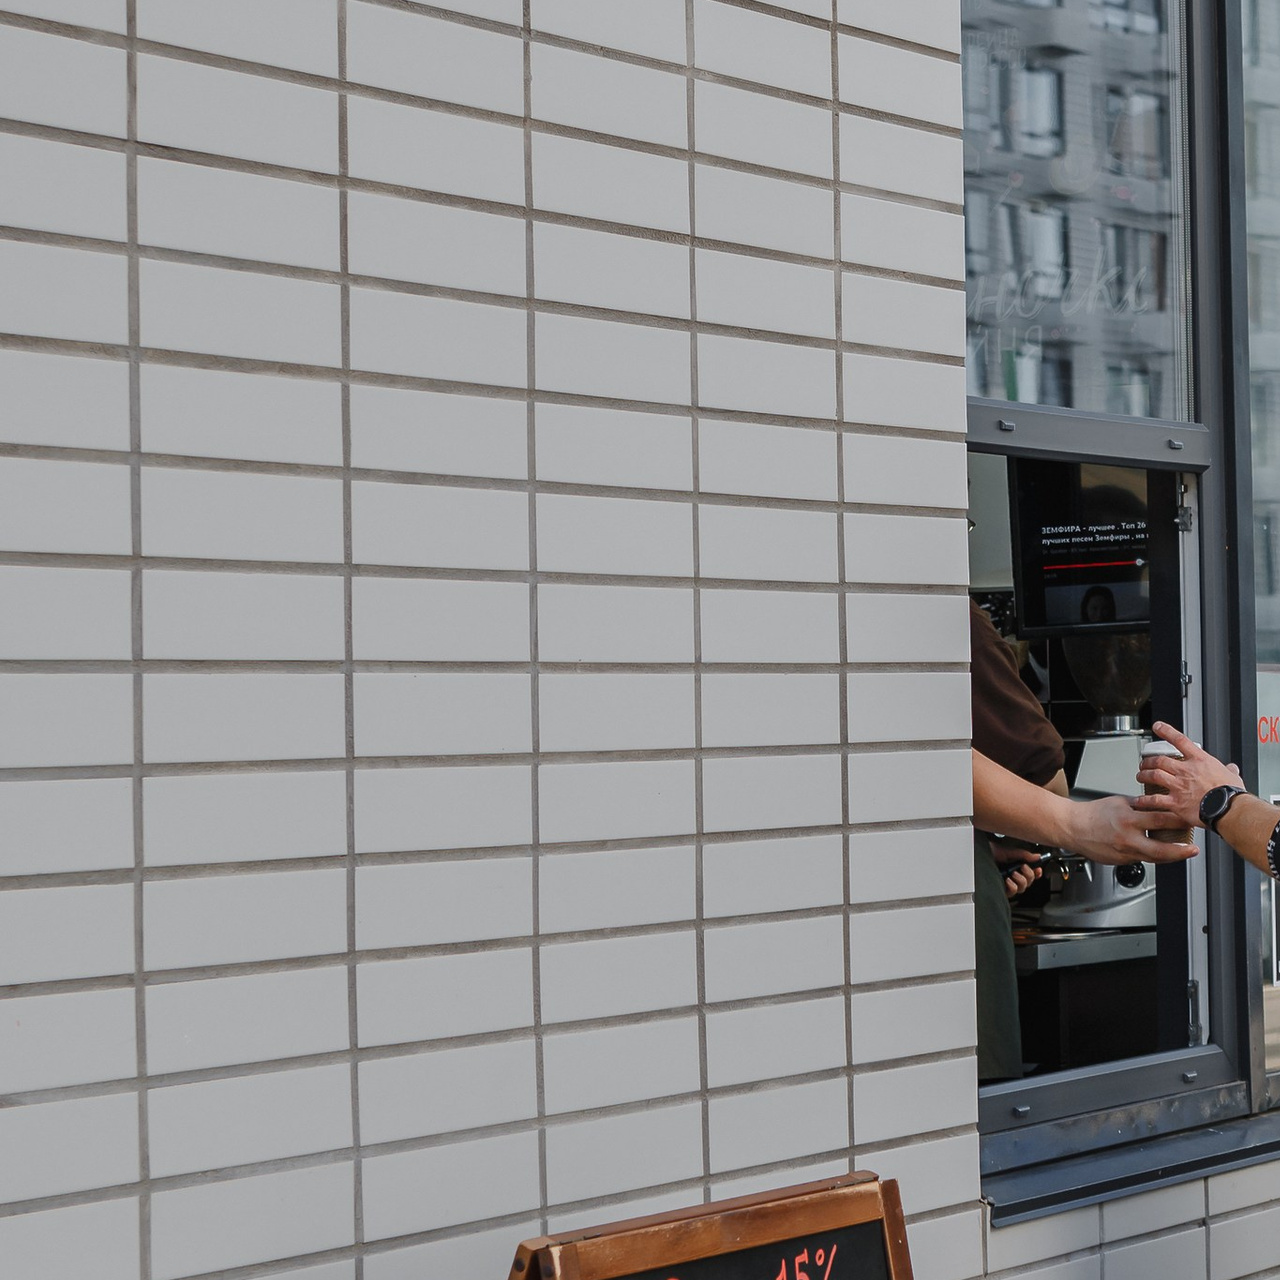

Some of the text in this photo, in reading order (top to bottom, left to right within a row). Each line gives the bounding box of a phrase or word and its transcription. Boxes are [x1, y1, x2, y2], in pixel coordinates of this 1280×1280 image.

[1041, 525, 1081, 535] ЗЕМФИРА
[1088, 524, 1116, 533] лучшее
[1121, 522, 1136, 530] Топ
[1137, 521, 1147, 529] 26
[1041, 537, 1071, 546] лучших
[1071, 535, 1094, 544] песен
[1095, 533, 1130, 543] Земфиры
